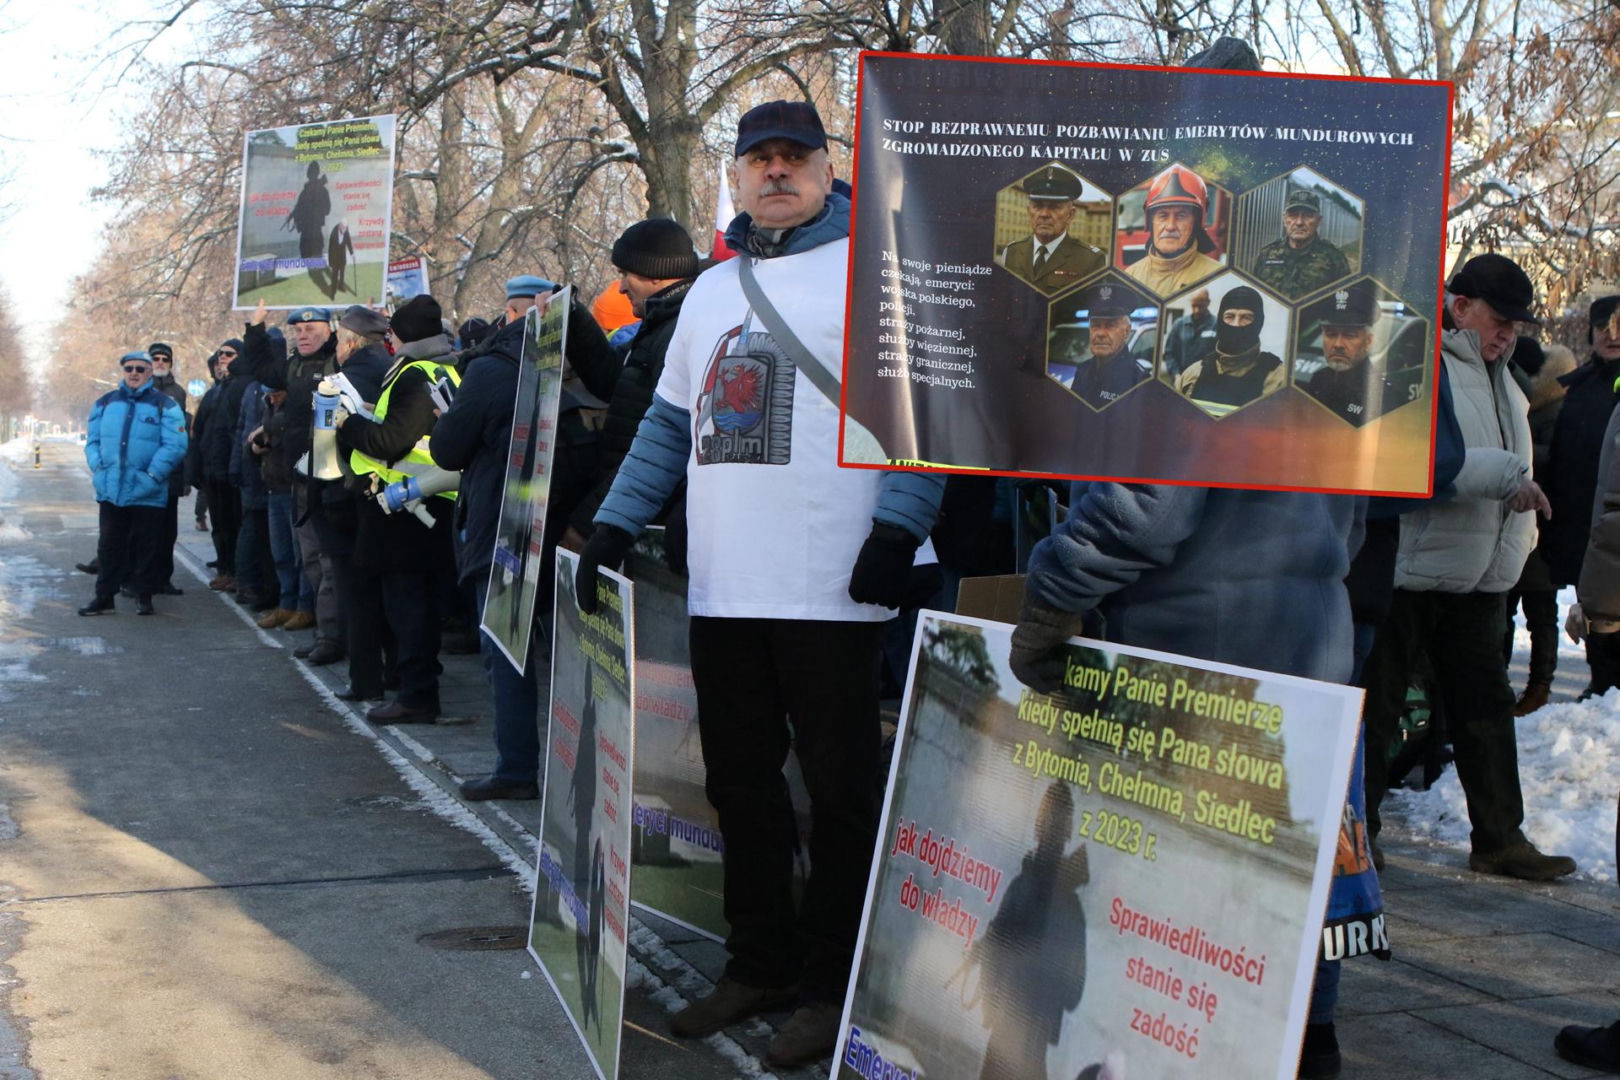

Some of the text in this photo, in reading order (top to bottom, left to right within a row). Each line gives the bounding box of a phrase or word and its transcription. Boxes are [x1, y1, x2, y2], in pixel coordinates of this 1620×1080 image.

[883, 118, 1414, 146] STOP BEZPRAWNEMU POZBAWIANIU EMERYTÓW MUNDUROWYCH
[882, 137, 1169, 162] ZGROMADZONEGO KAPITAŁU W ZUS
[882, 250, 993, 277] Na swoje pieniądze
[881, 268, 975, 292] czekają emeryci:
[881, 284, 917, 300] wojska
[879, 317, 916, 332] straży
[879, 333, 915, 349] służby
[877, 366, 910, 379] służb
[878, 350, 914, 365] straży
[1347, 403, 1363, 415] SW
[1064, 656, 1284, 735] kamy Panie Premierze
[1017, 690, 1284, 790] kiedy spełnią się Pana słowa
[1012, 742, 1024, 765] z
[1025, 739, 1093, 795] Bytomia,
[1098, 761, 1187, 823] Chełmna,
[1193, 790, 1277, 845] Siedlec
[633, 803, 668, 837] eryci
[1079, 810, 1157, 862] z 2023 r.
[891, 818, 1003, 904] jak dojdziemy
[900, 872, 979, 950] do władzy
[1109, 896, 1267, 986] Sprawiedliwości
[1126, 956, 1218, 1024] stanie się
[1130, 1007, 1200, 1059] zadość
